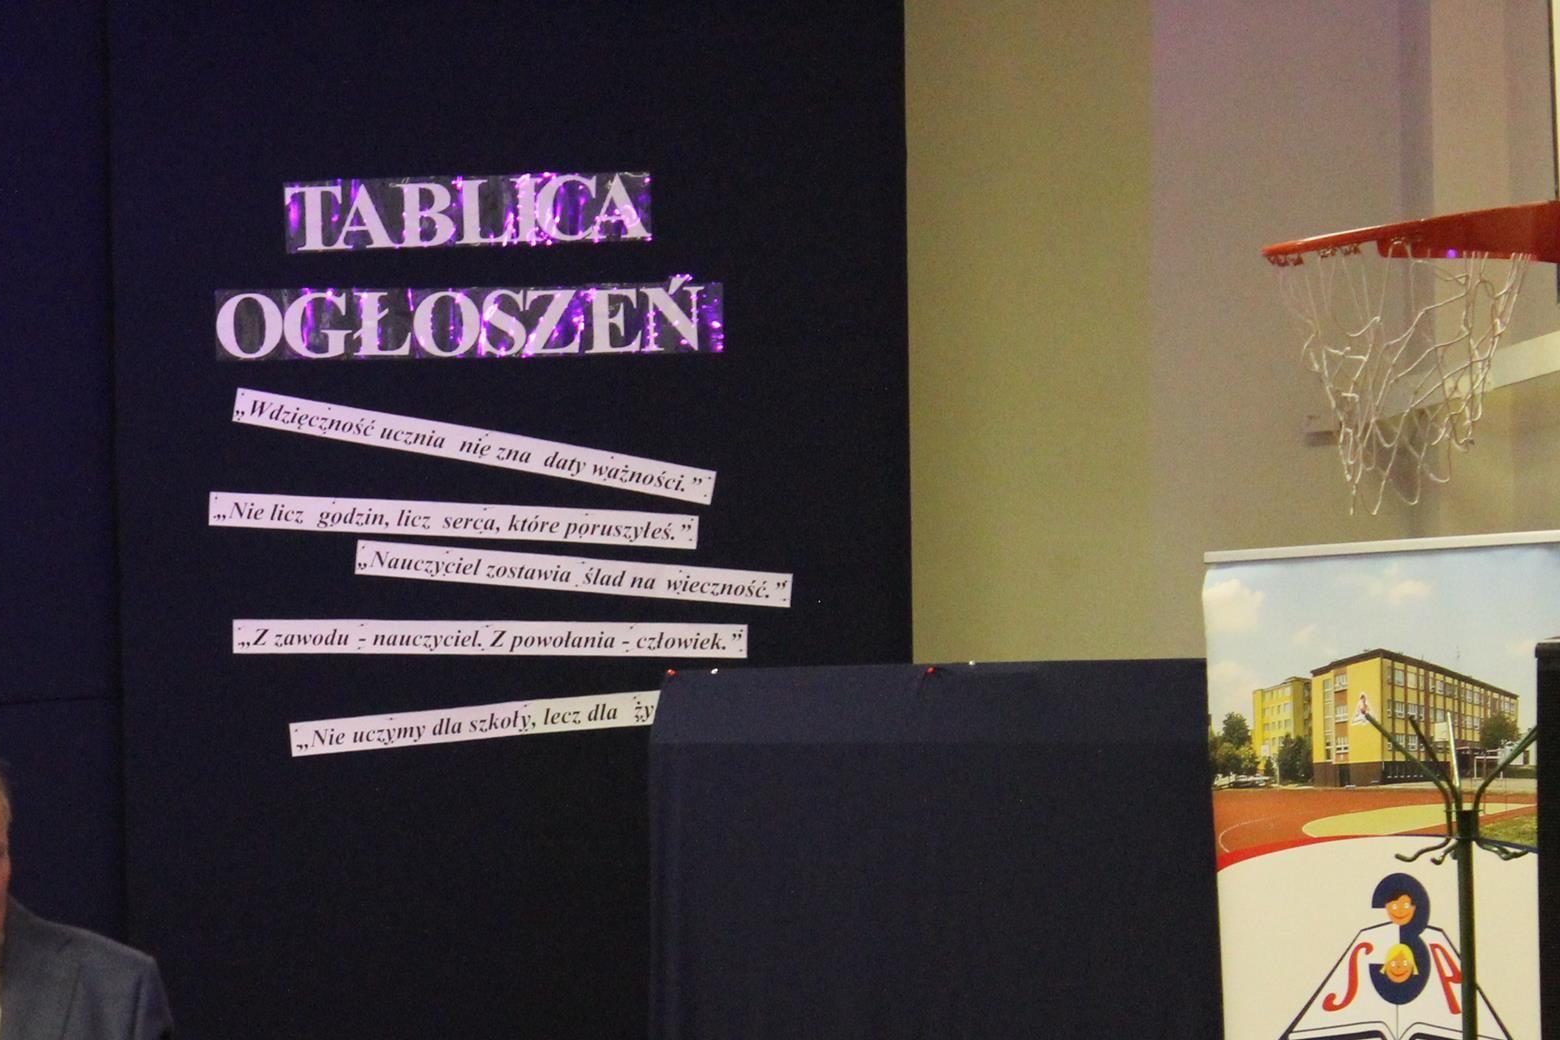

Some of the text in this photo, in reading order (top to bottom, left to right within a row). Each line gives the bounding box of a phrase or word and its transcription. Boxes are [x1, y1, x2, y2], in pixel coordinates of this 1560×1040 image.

[284, 173, 652, 251] TABLICA
[215, 276, 705, 360] OGŁOSZEŃ
[379, 426, 447, 450] ucznia
[496, 446, 533, 464] zna
[543, 451, 587, 477] daty
[216, 501, 265, 522] „Nie
[270, 503, 305, 524] licz
[316, 507, 390, 529] godzin,
[396, 509, 432, 530] licz
[442, 514, 501, 533] serca,
[507, 514, 561, 534] które
[357, 550, 483, 577] „Nauczyciel
[486, 563, 572, 583] zostawia
[582, 567, 627, 588] ślad
[629, 576, 657, 590] na
[274, 628, 349, 647] zawodu
[372, 629, 482, 651] nauczyciel.
[489, 629, 508, 648] Z
[509, 630, 615, 652] powołania
[296, 728, 346, 750] „Nie
[352, 725, 426, 746] uczymy
[432, 717, 463, 736] dla
[469, 709, 536, 733] szkoły,
[543, 707, 582, 725] lecz
[587, 703, 618, 722] dla
